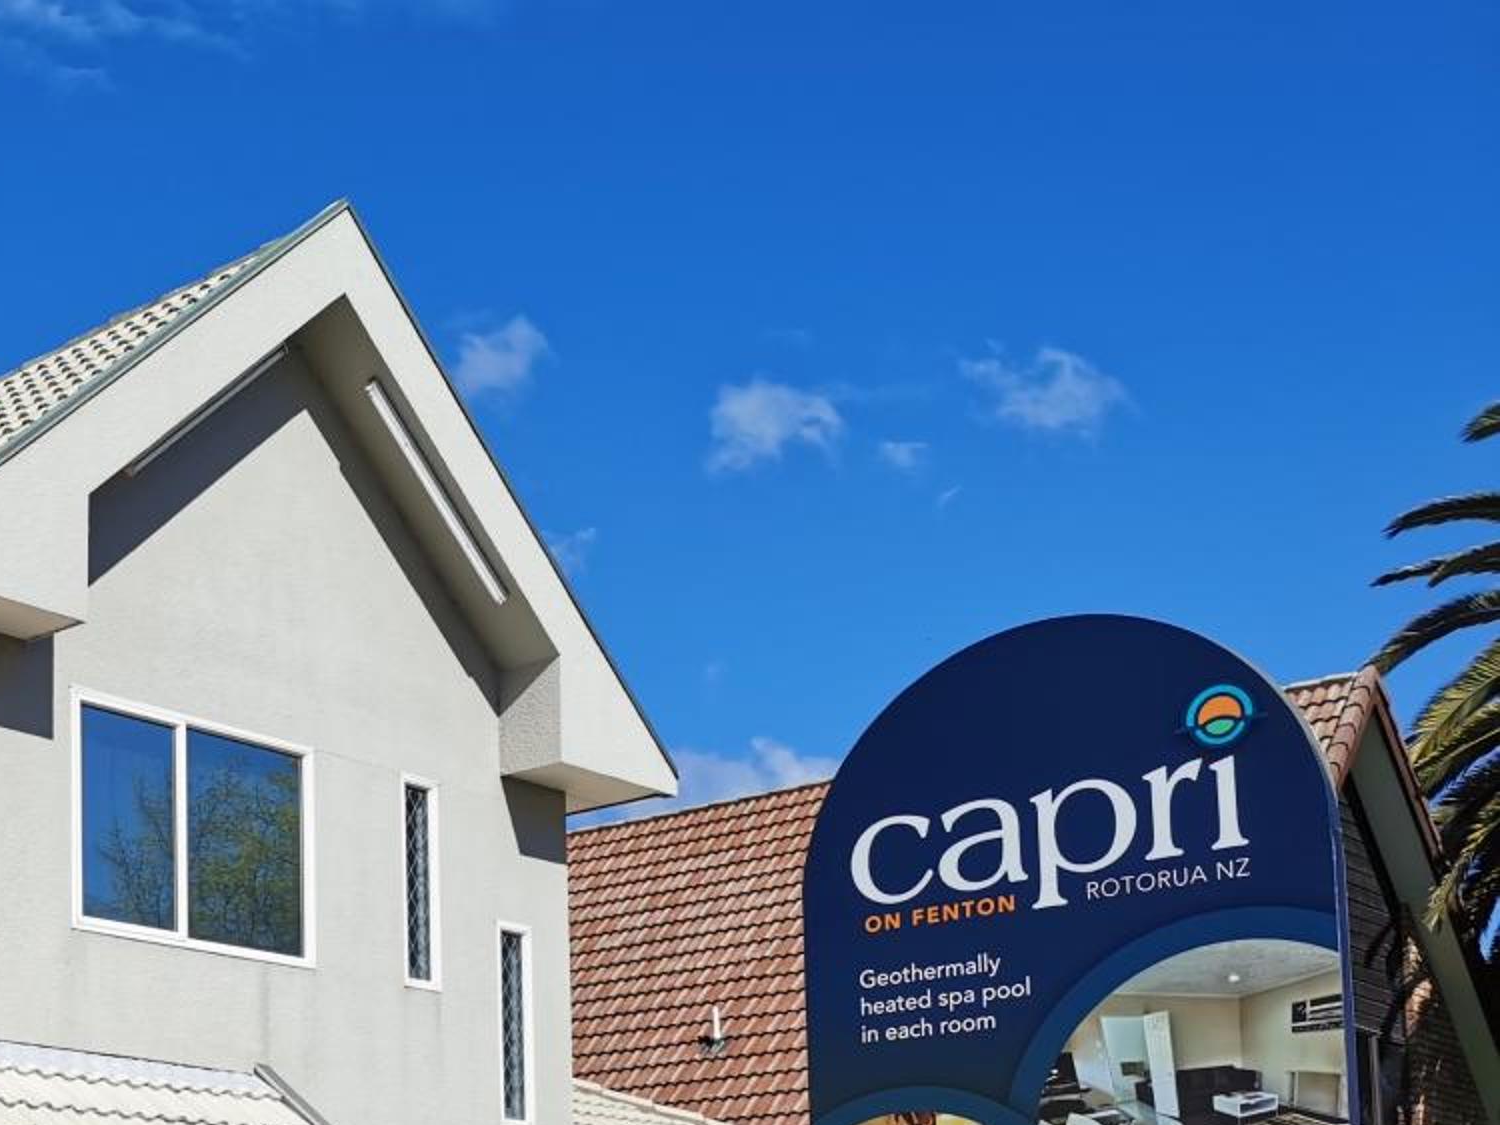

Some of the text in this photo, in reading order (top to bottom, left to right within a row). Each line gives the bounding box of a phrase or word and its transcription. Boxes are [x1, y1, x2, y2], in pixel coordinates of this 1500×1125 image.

[850, 755, 1251, 910] capri
[1086, 857, 1252, 900] ROTORUA NZ
[864, 894, 1017, 934] ON FENTON
[859, 952, 1002, 990] Geothermally
[860, 975, 1032, 1017] heated spa pool
[861, 1015, 997, 1044] in each room
